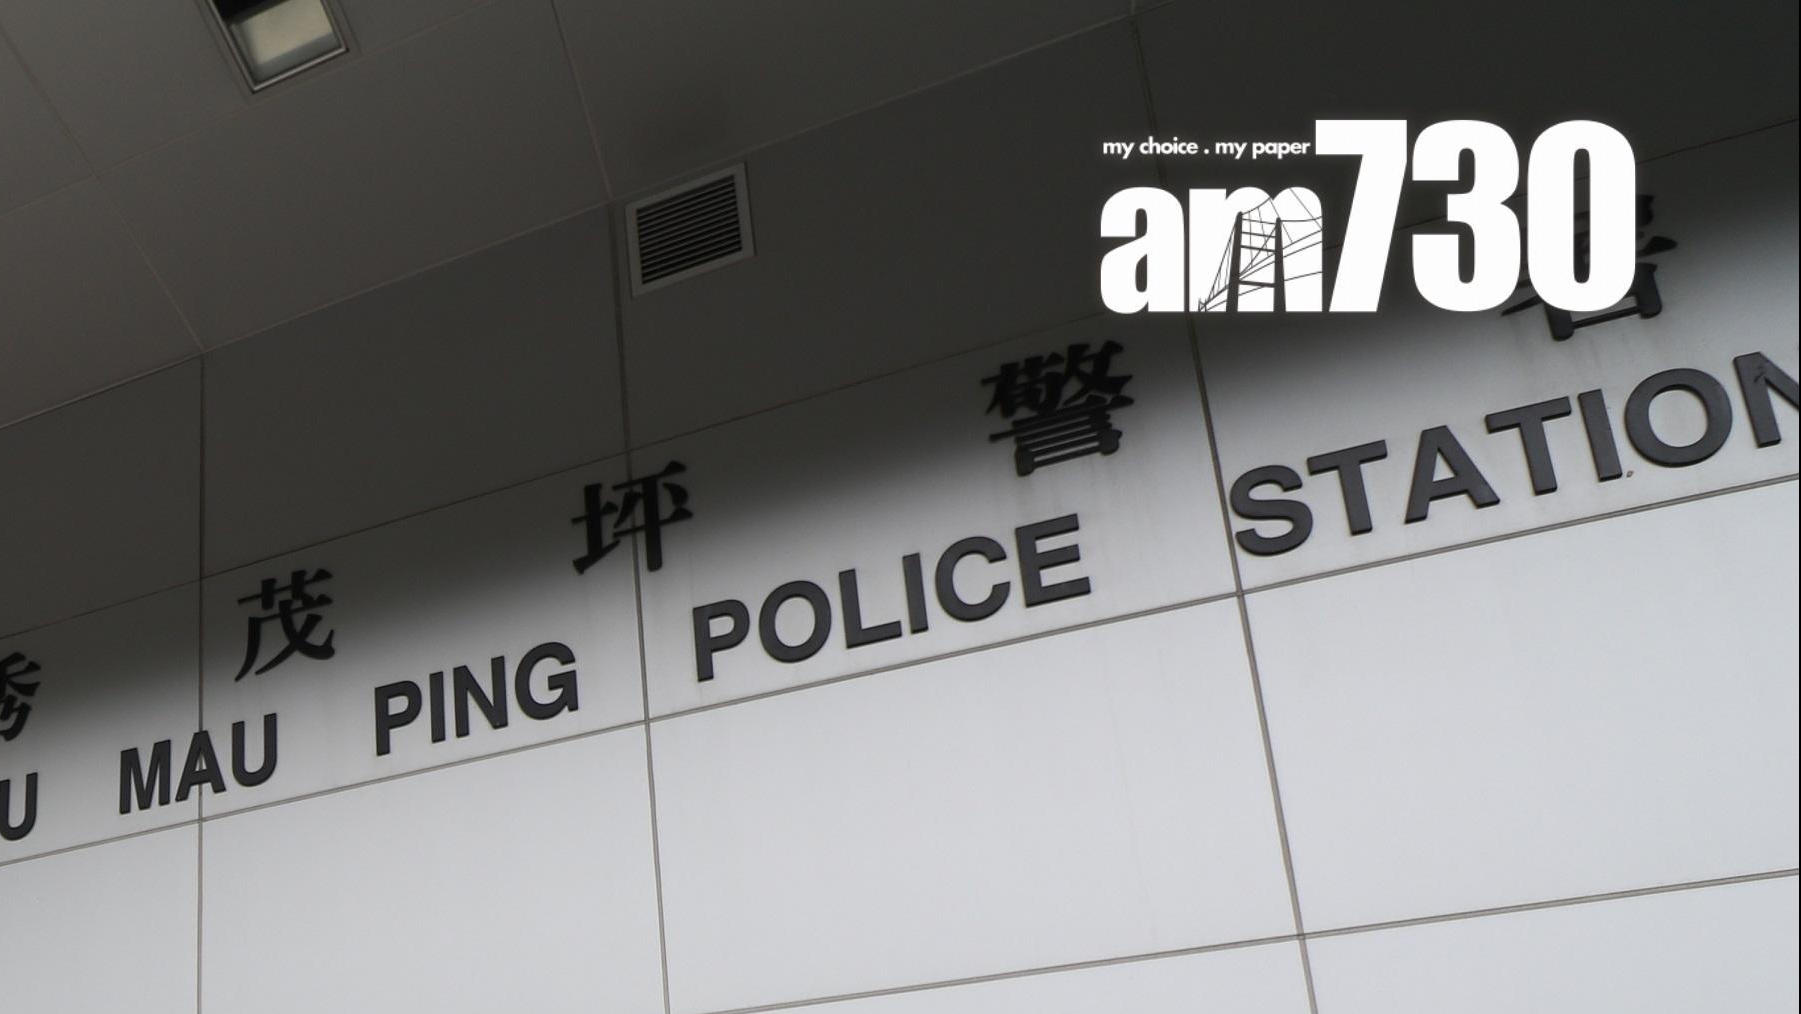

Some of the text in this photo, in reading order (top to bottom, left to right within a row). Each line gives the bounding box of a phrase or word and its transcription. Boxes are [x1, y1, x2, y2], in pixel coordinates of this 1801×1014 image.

[120, 713, 278, 814] MAU
[374, 641, 579, 756] PING
[692, 513, 1091, 682] POLICE
